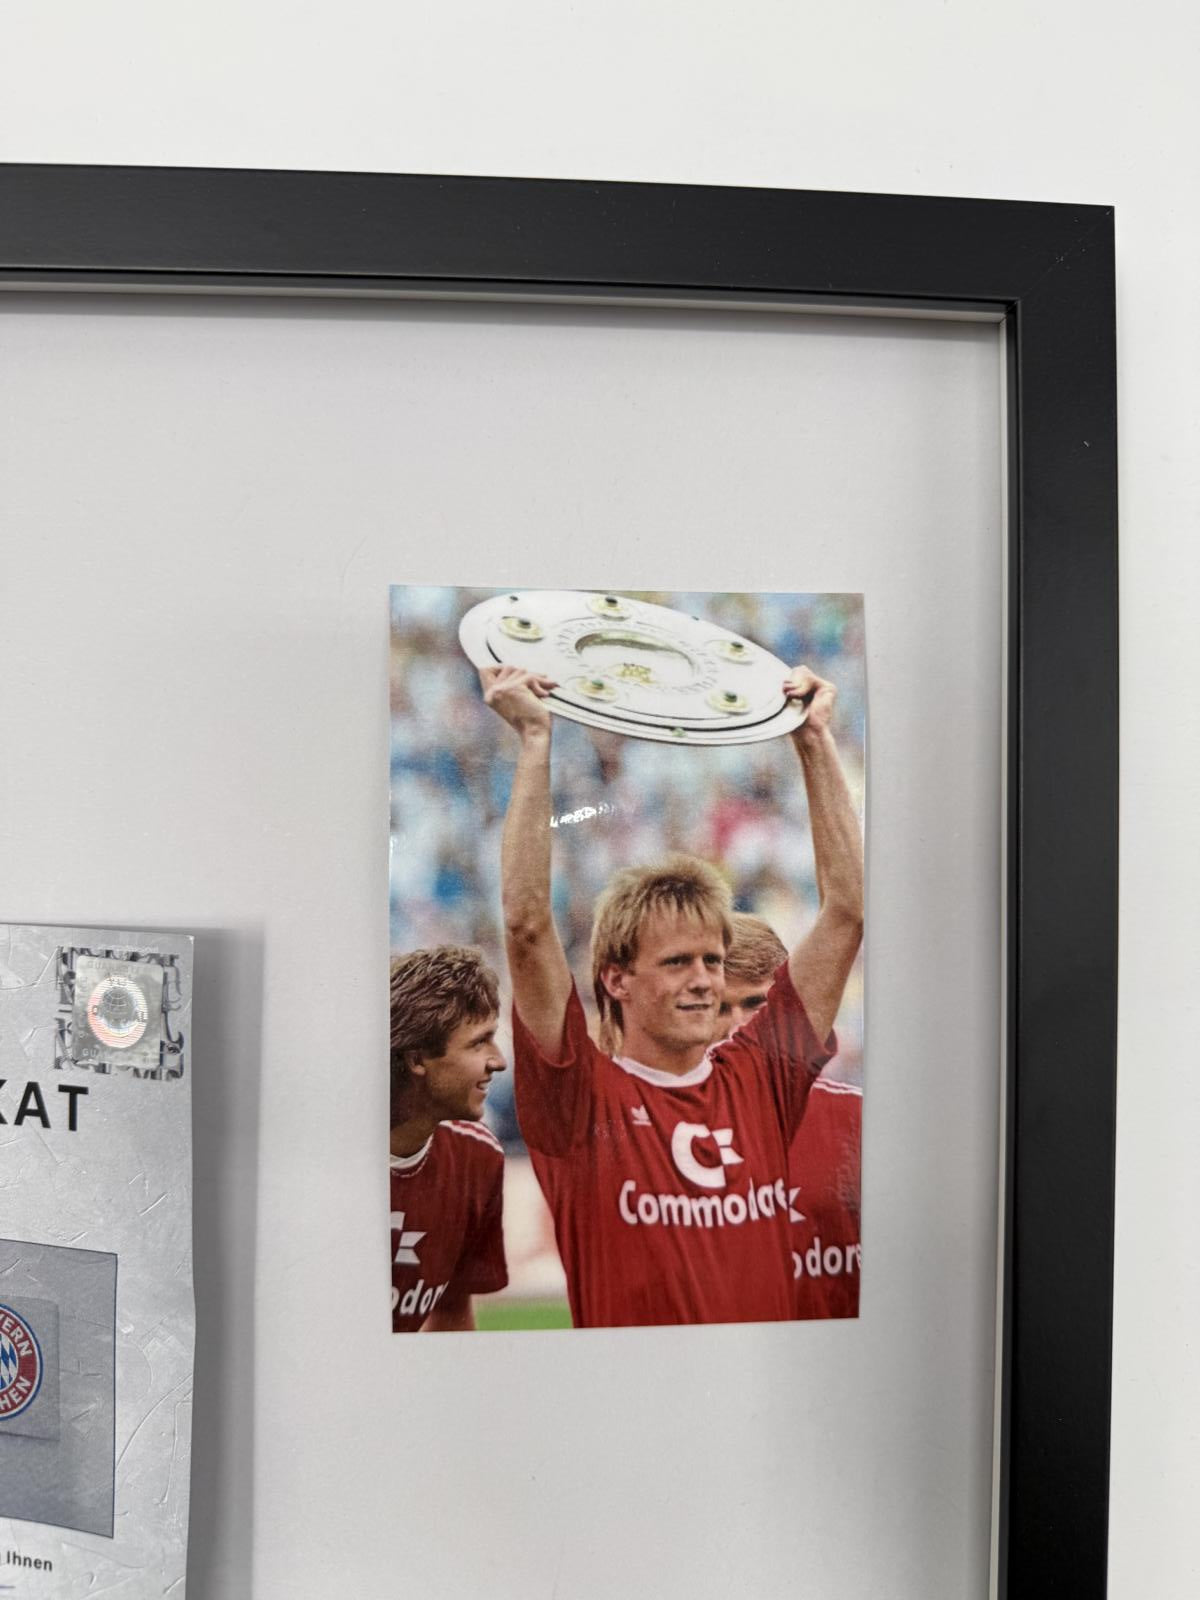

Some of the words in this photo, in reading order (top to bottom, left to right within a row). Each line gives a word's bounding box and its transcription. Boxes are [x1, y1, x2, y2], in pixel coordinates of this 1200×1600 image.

[0, 1079, 89, 1132] AT
[618, 1177, 788, 1228] Commodo
[791, 1236, 861, 1280] dor
[0, 1313, 32, 1356] ERN
[7, 1550, 53, 1572] Ihnen
